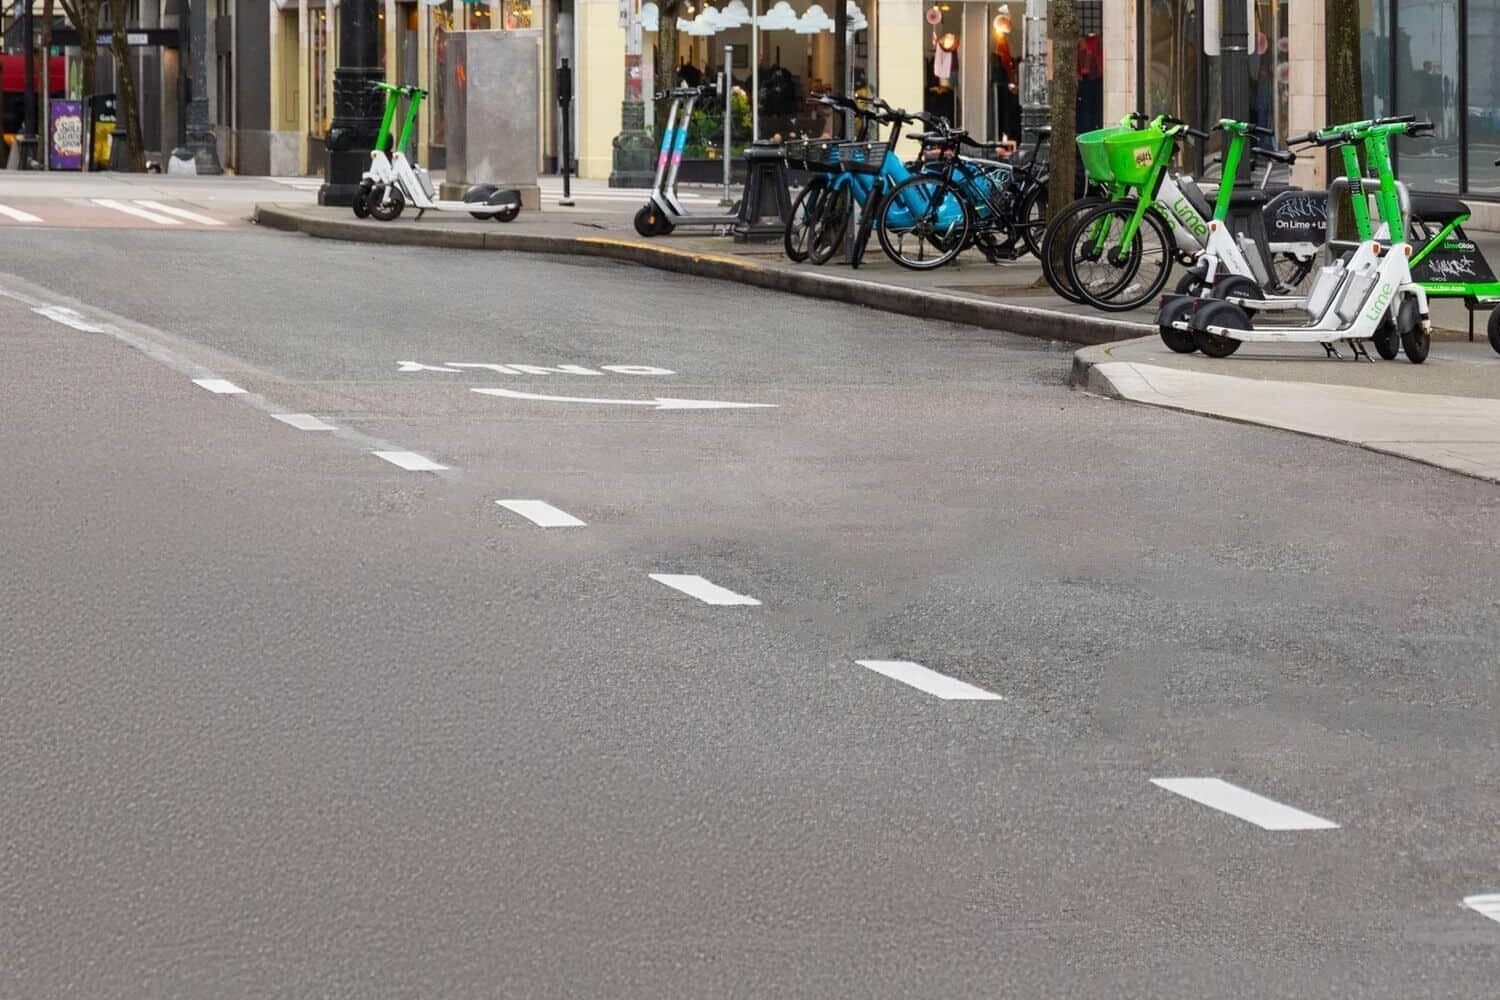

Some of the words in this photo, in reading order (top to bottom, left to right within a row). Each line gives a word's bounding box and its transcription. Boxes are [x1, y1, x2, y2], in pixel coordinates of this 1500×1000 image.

[1173, 197, 1208, 237] Lime
[1275, 220, 1289, 229] On
[1290, 220, 1311, 229] Lime
[1366, 283, 1392, 321] Lime
